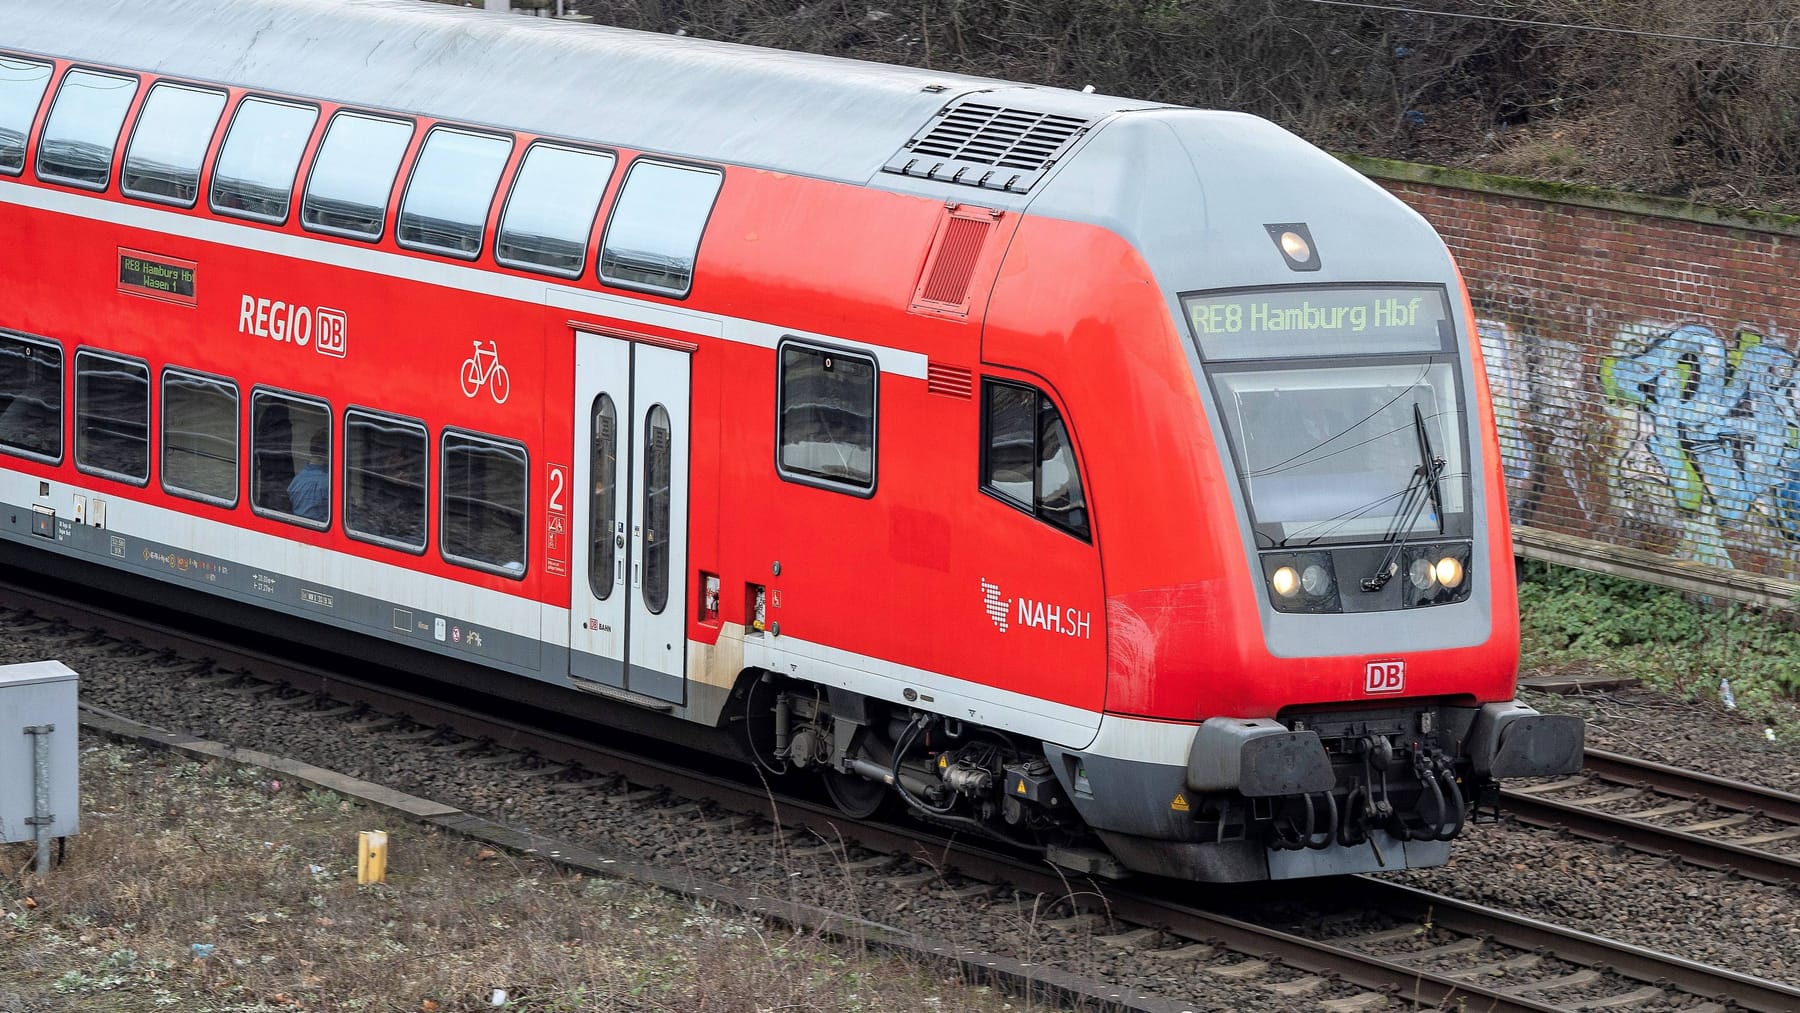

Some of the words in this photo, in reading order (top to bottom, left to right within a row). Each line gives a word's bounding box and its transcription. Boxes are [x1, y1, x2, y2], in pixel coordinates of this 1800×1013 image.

[124, 258, 140, 272] RE8
[143, 262, 178, 280] Hamburg
[143, 275, 170, 291] Wagen
[172, 280, 177, 293] 1
[238, 294, 312, 347] REGIO
[319, 312, 345, 351] DB
[1191, 303, 1242, 334] RE8
[1250, 301, 1367, 333] Hamburg
[1374, 296, 1424, 328] Hbf
[549, 468, 564, 511] 2
[599, 623, 612, 633] BAHN
[1018, 597, 1091, 640] NAH.SH
[1367, 662, 1404, 691] DB
